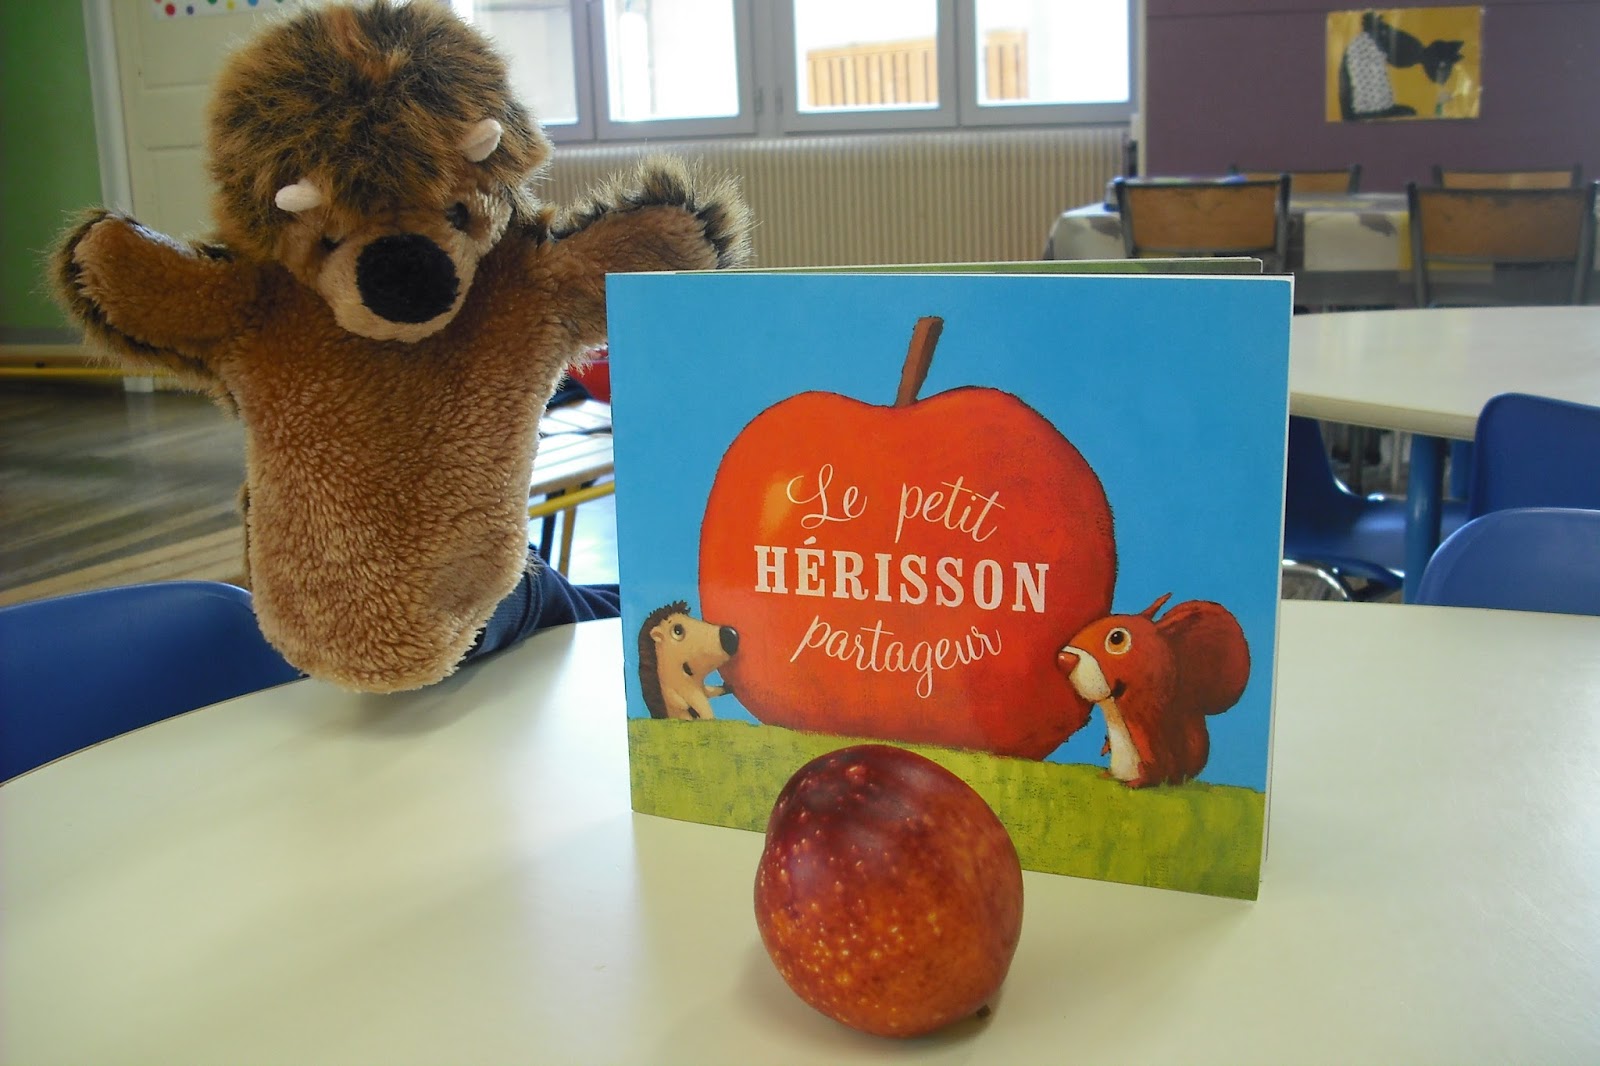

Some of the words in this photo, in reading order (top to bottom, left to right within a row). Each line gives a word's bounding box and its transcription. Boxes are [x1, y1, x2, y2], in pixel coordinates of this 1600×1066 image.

[786, 463, 868, 530] Le
[894, 475, 1006, 543] petit
[753, 535, 1050, 613] HÉRISSON
[789, 614, 1002, 699] partageur
